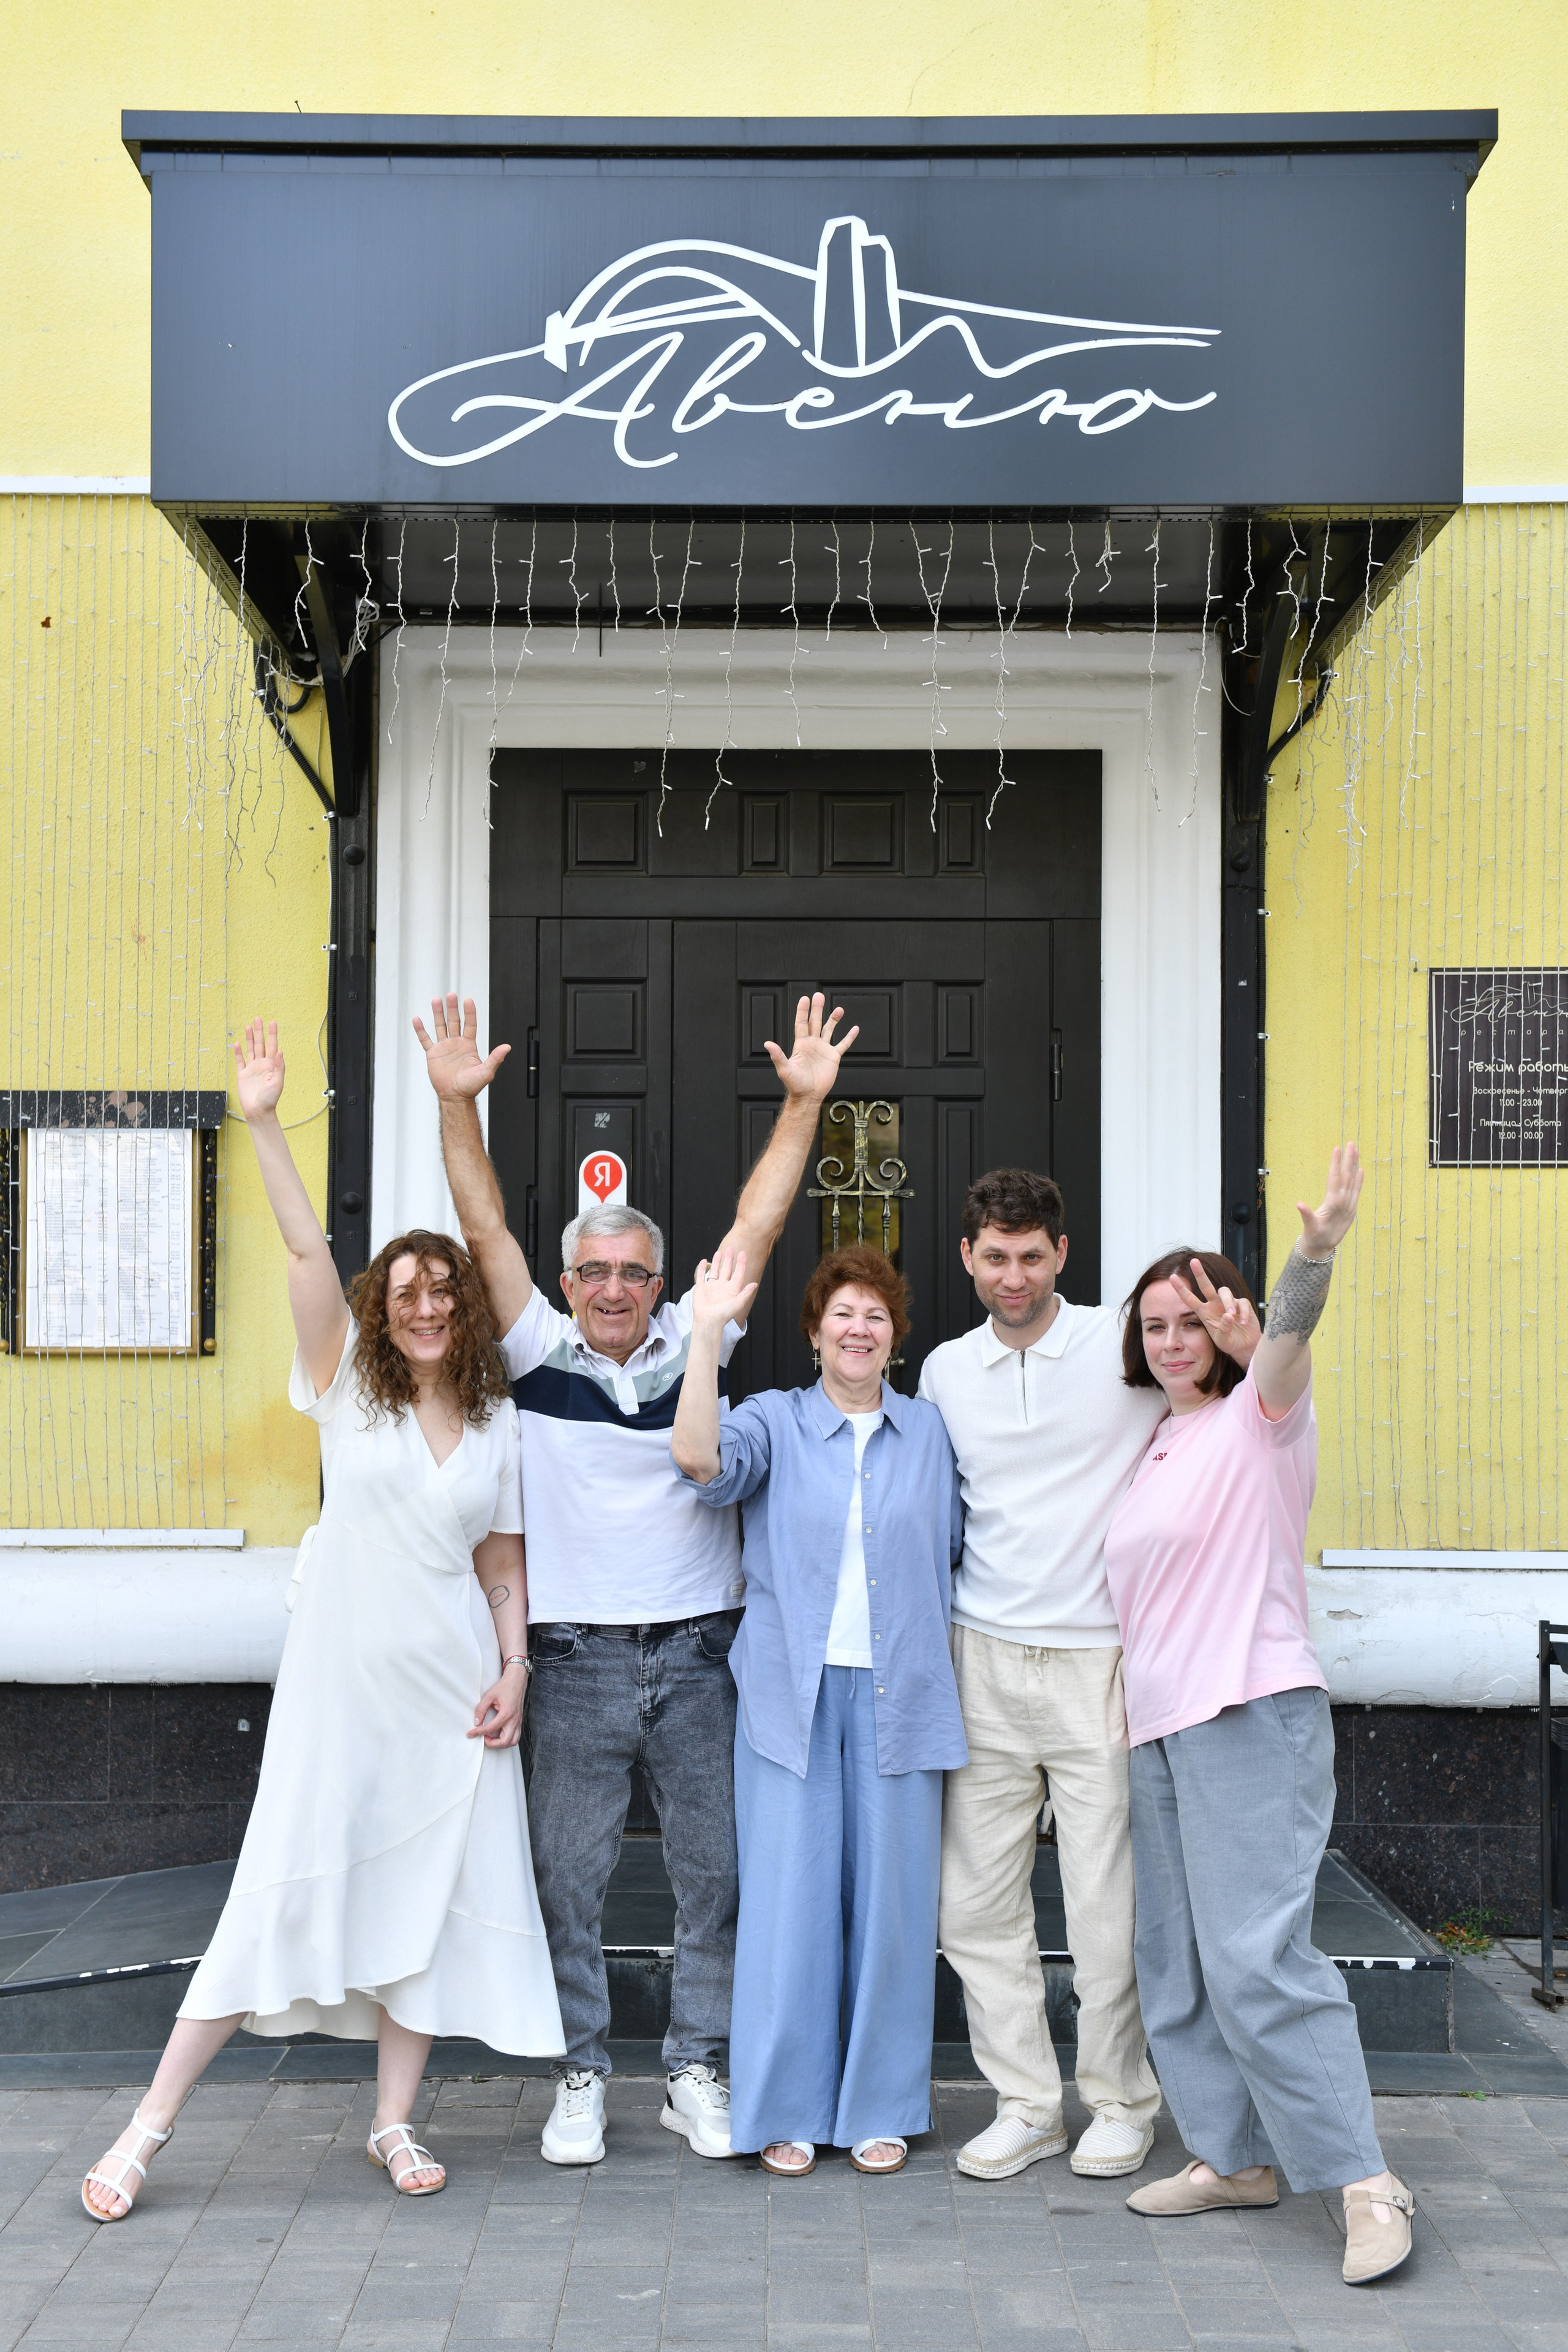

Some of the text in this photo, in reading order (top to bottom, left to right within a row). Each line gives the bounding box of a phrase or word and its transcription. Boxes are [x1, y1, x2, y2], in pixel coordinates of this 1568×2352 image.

[1468, 1061, 1514, 1072] Режим
[1524, 1118, 1562, 1128] Суббота
[594, 1162, 610, 1187] Я
